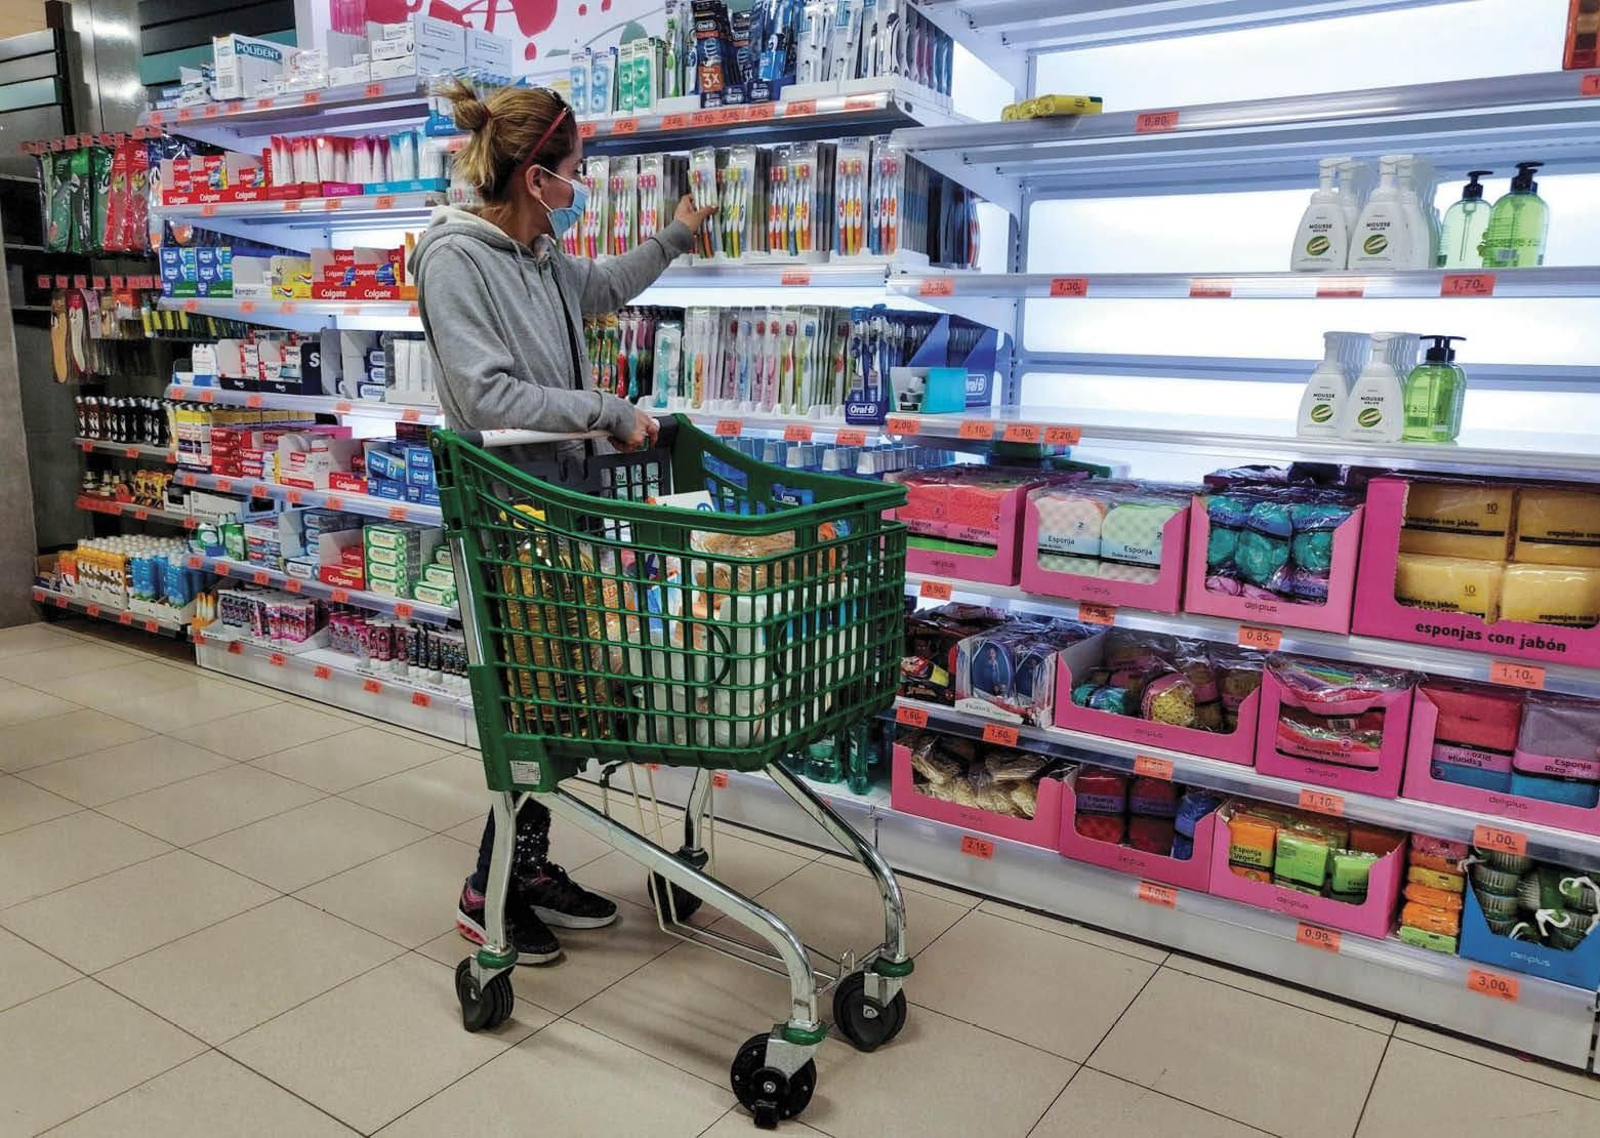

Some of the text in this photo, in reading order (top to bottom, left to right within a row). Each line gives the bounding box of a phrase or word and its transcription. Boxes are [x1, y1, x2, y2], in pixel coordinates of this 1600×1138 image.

[236, 42, 280, 60] POLIDENT
[169, 196, 189, 206] Colgate
[199, 193, 221, 203] Colgate
[235, 191, 257, 202] Colgate
[321, 289, 347, 299] Colgate
[364, 289, 391, 299] Colgate
[849, 405, 876, 415] Oral-B
[336, 480, 361, 491] Colgate
[1486, 502, 1498, 512] 10
[1047, 535, 1075, 547] Esponja
[1123, 545, 1153, 557] Esponja
[328, 574, 354, 586] Colgate
[1464, 584, 1476, 595] 10
[1415, 621, 1567, 653] esponjas con jabón
[1544, 765, 1567, 774] Rizo
[1554, 758, 1592, 771] Esponja
[1488, 796, 1529, 811] deliplus
[1233, 845, 1263, 858] Esponja
[1510, 951, 1551, 967] deliplus
